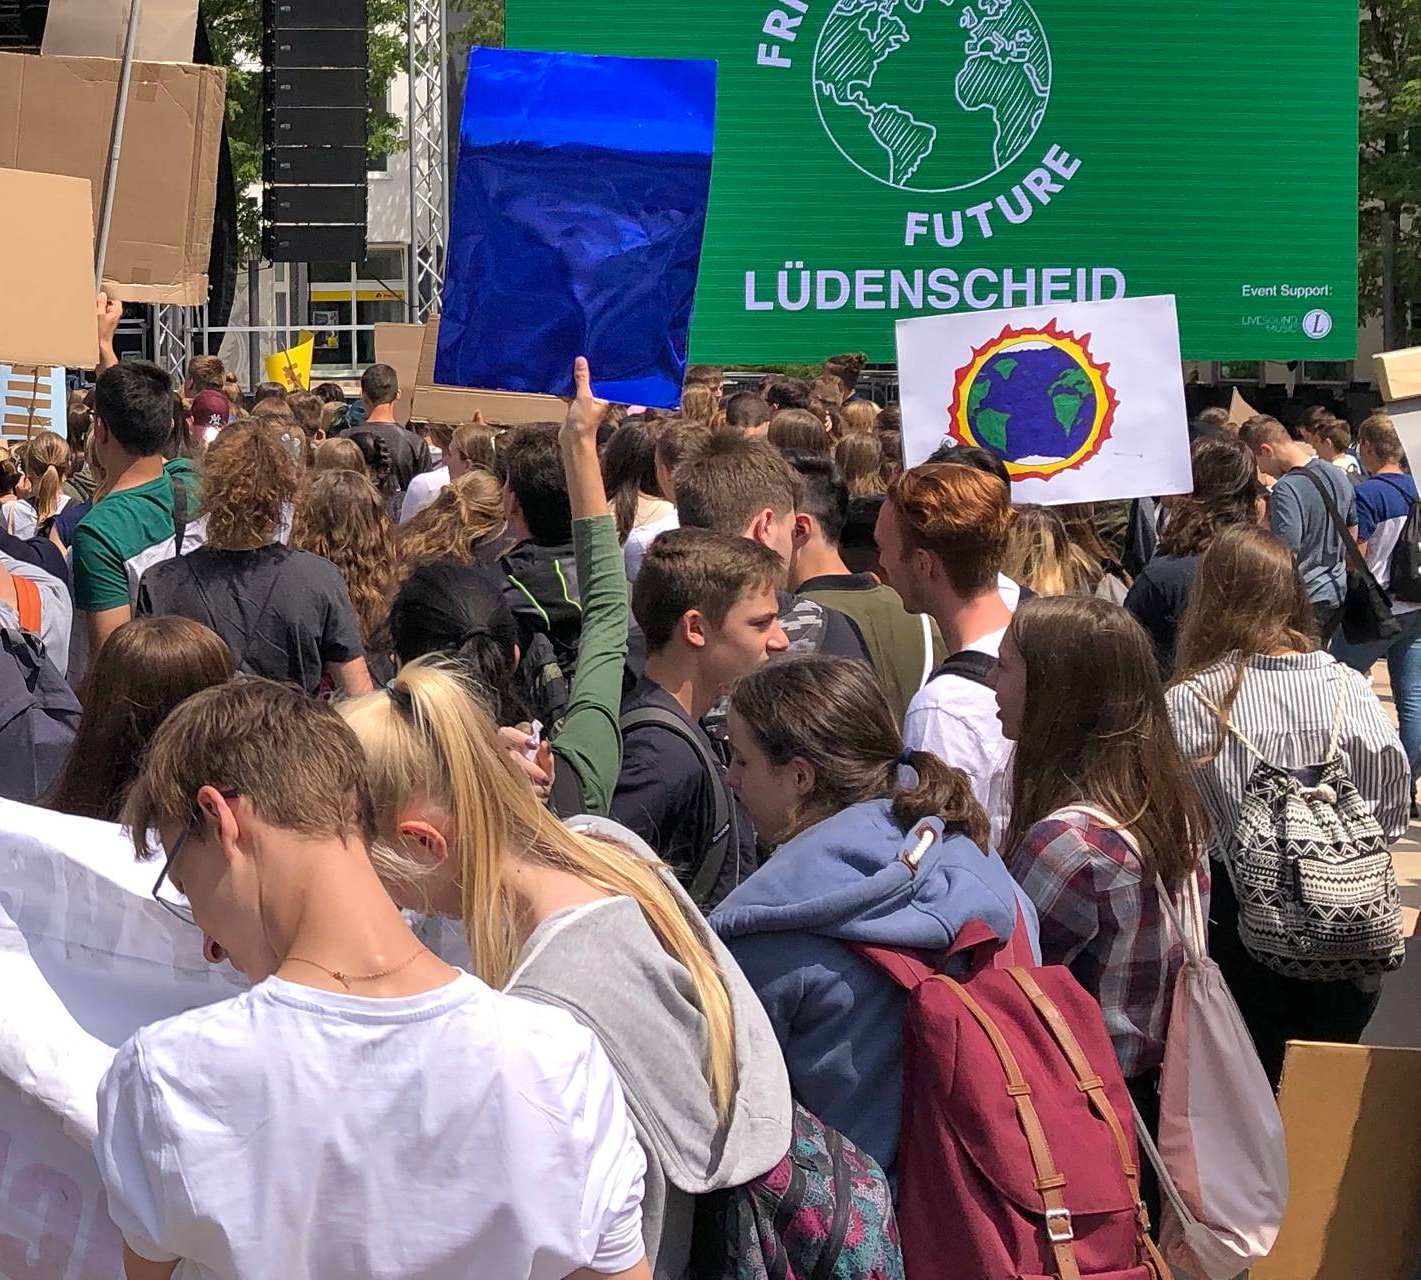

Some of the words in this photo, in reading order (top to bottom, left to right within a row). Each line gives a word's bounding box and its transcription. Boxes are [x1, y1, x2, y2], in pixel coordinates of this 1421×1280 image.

[757, 0, 809, 68] FRI
[904, 143, 1082, 249] FUTURE
[745, 261, 1126, 311] LÜDENSCHEID
[1242, 284, 1277, 297] Event
[1280, 284, 1333, 299] Support:
